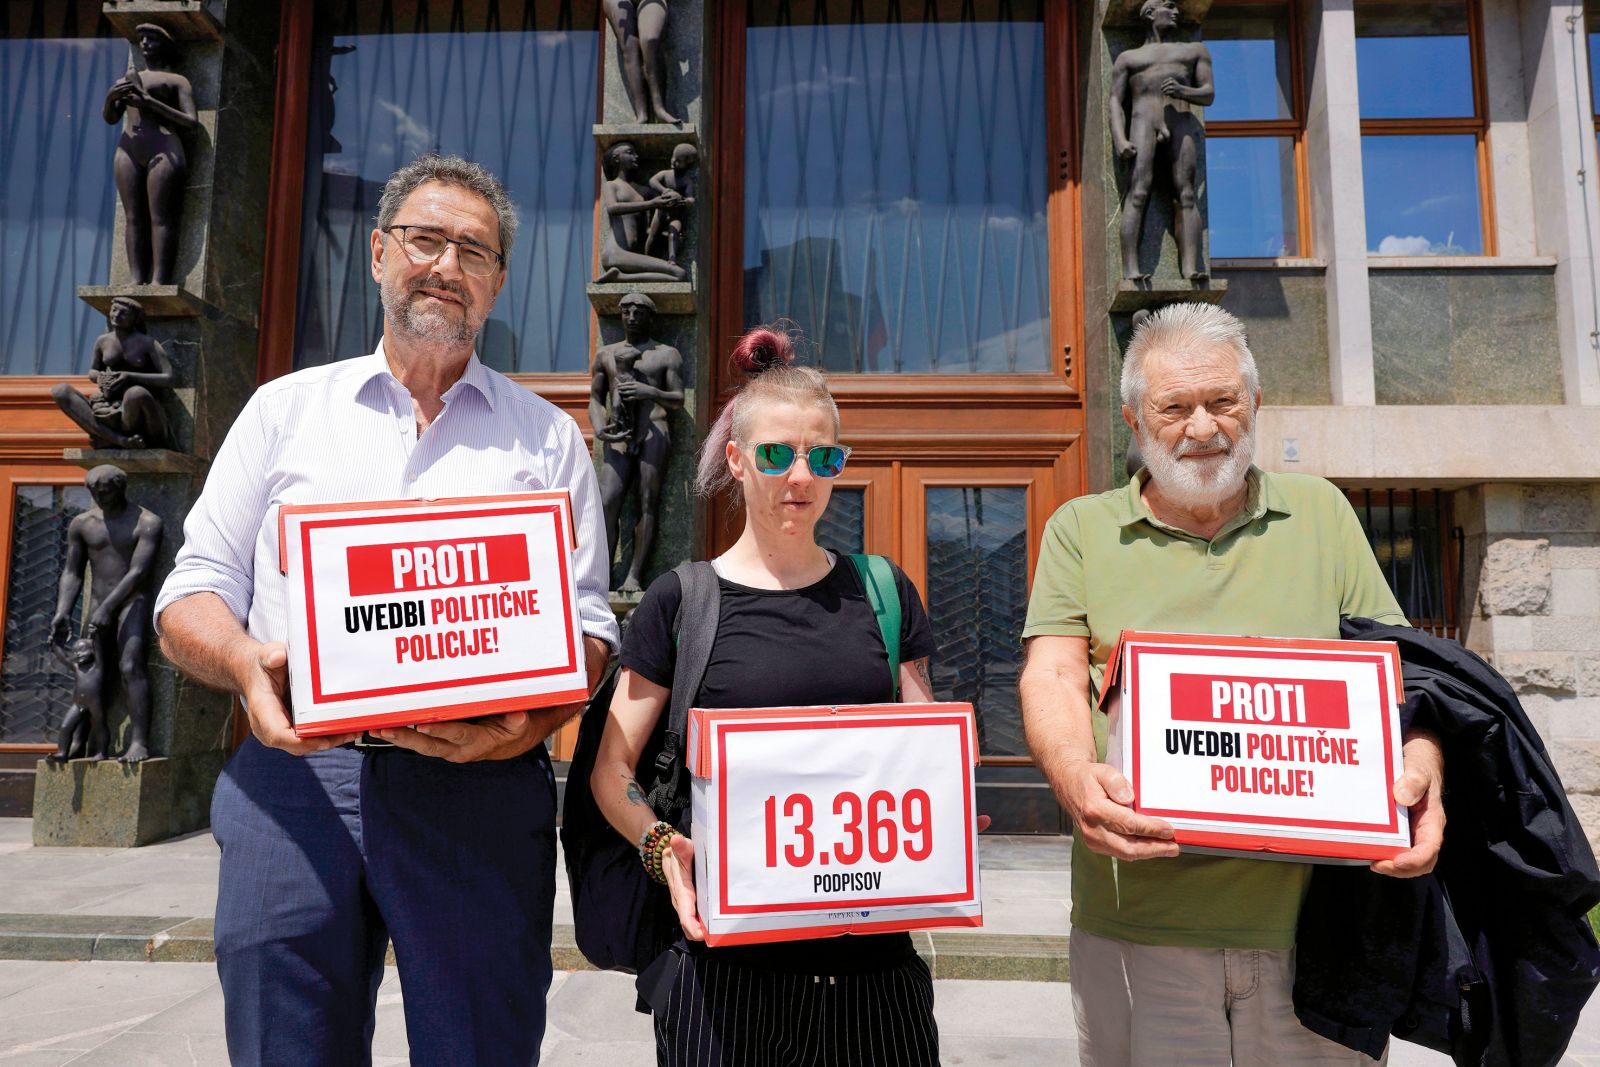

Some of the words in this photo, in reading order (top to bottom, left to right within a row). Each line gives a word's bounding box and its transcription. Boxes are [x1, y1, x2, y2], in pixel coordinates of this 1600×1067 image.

[391, 541, 489, 590] PROTI
[344, 599, 426, 634] UVEDBI
[431, 585, 541, 625] POLITIČNE
[395, 626, 500, 664] POLICIJE!
[1211, 680, 1306, 723] PROTI
[1165, 728, 1241, 759] UVEDBI
[1246, 730, 1360, 766] POLITIČNE
[1210, 764, 1315, 798] POLICIJE!
[764, 788, 933, 868] 13.369
[813, 871, 882, 893] PODPISOV
[828, 911, 860, 919] PAPYRUS
